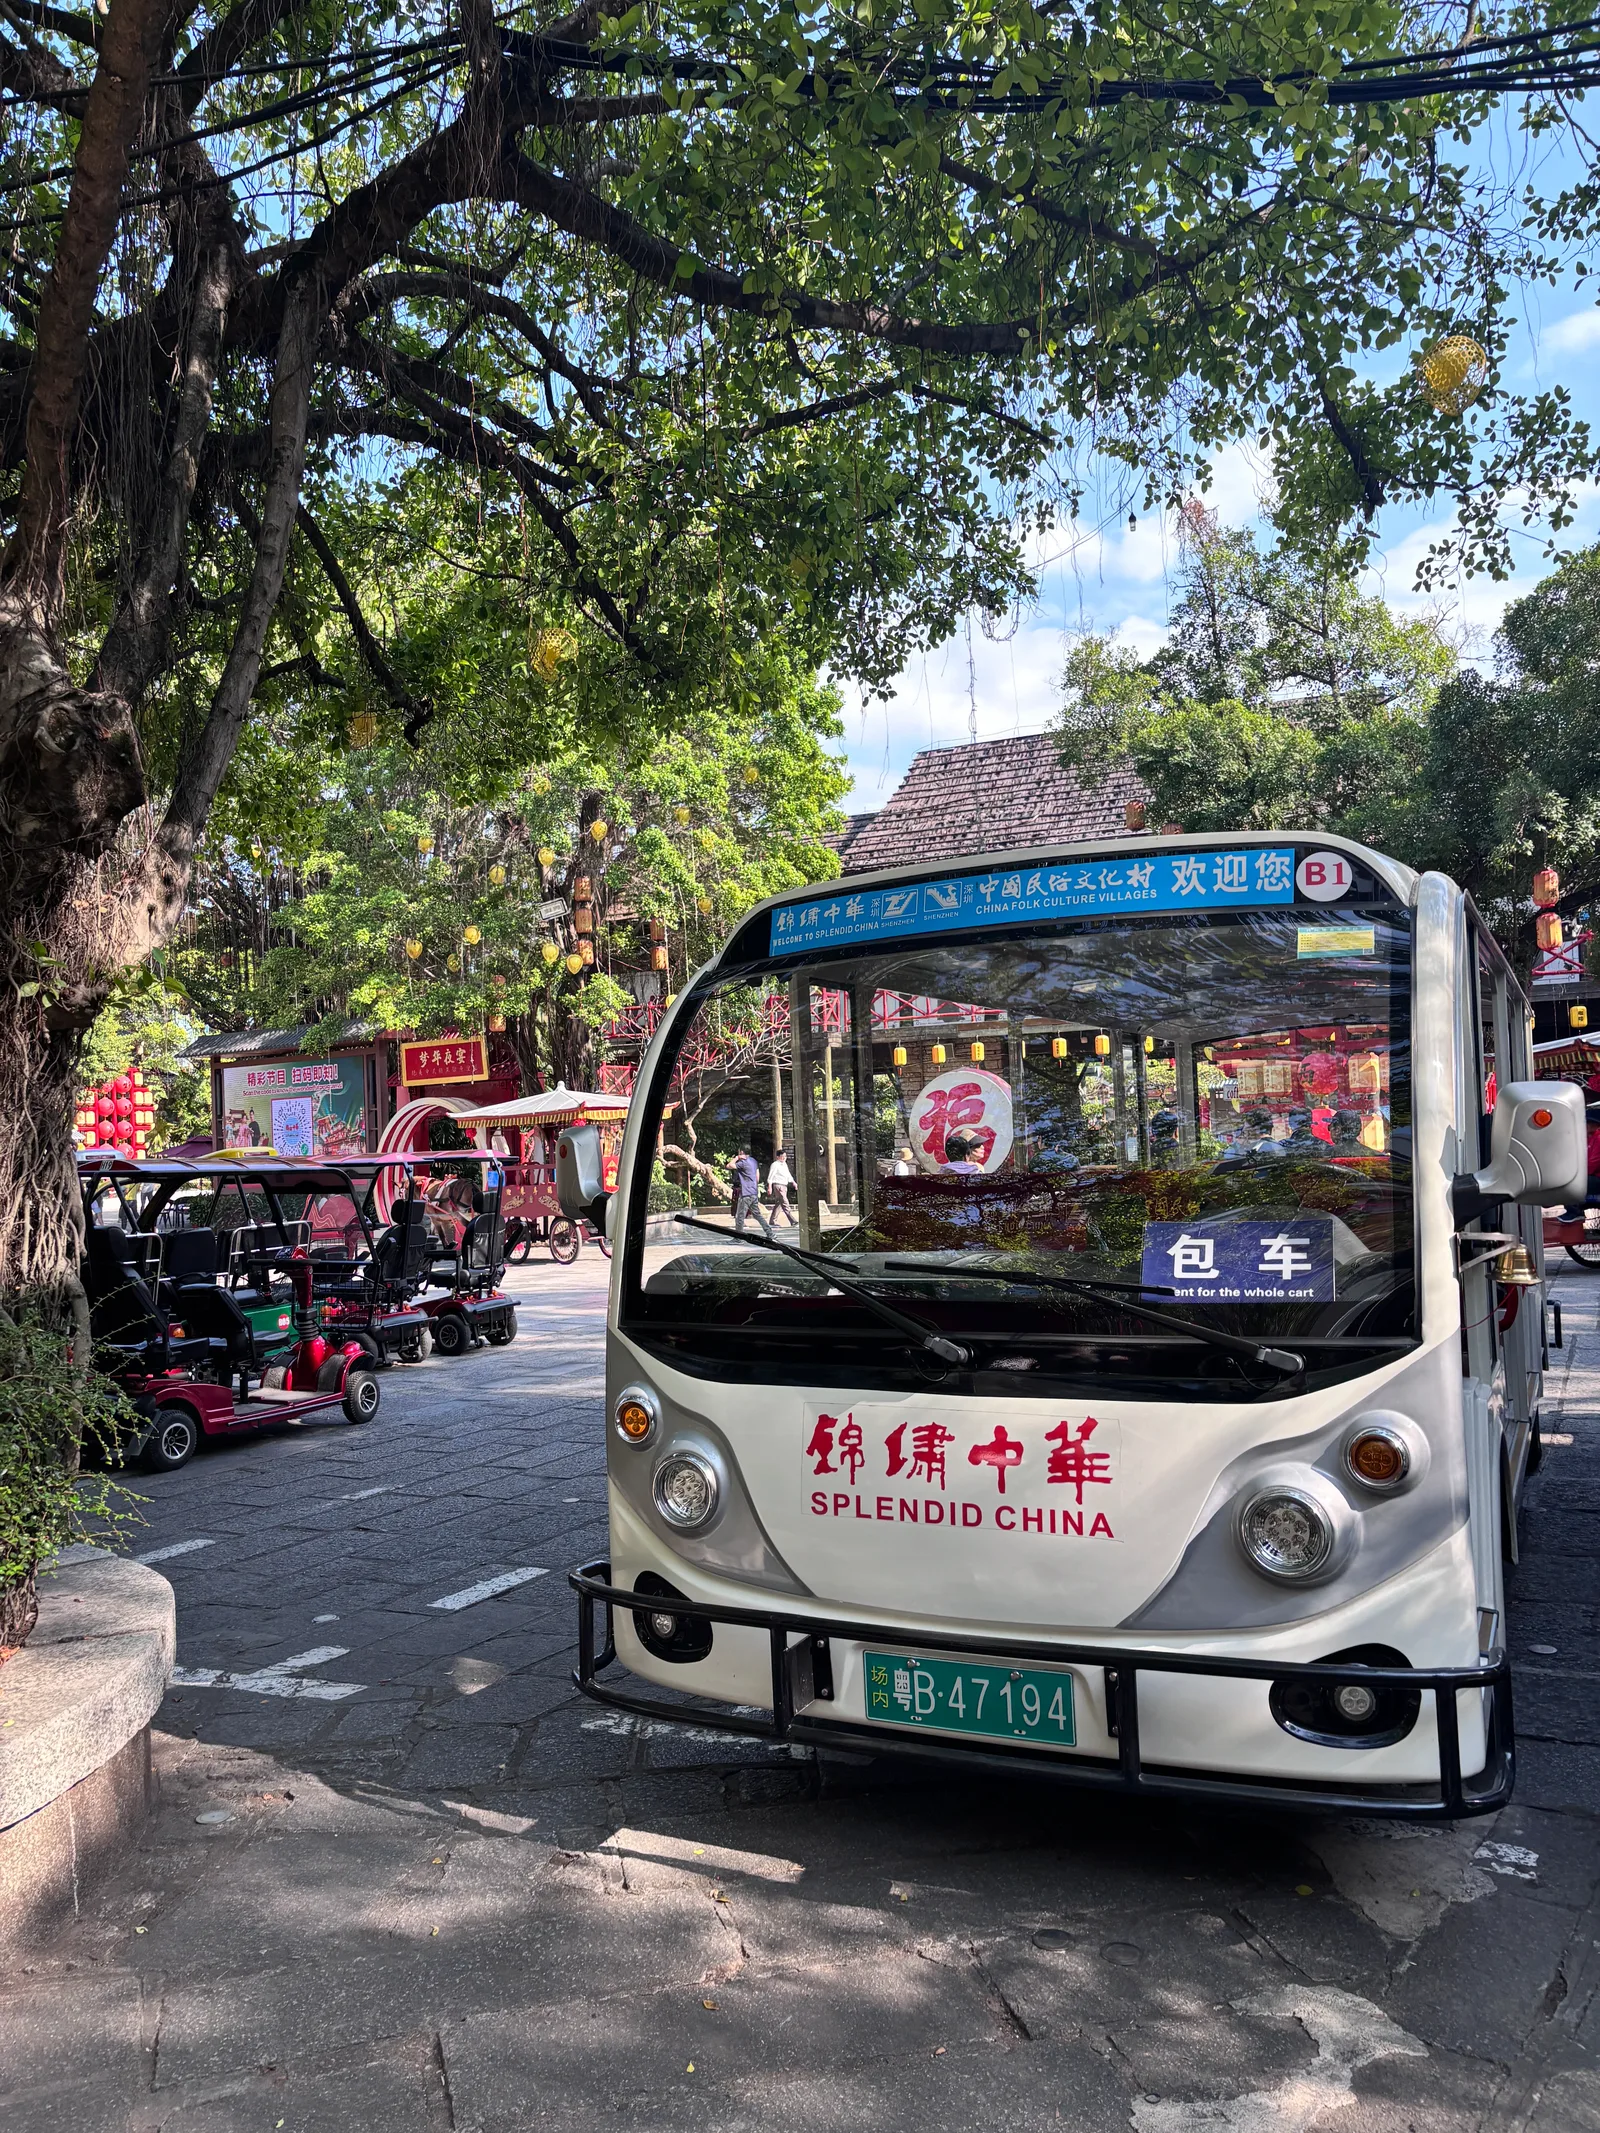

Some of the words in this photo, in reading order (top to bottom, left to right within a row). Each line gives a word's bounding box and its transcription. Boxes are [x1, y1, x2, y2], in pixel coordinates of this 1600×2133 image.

[1171, 852, 1292, 897] 欢迎您
[1305, 861, 1348, 886] B1
[963, 884, 974, 904] 深圳
[975, 903, 1009, 915] CHINA
[1011, 900, 1041, 911] FOLK
[1043, 894, 1096, 907] CULTURE
[1098, 889, 1157, 903] VILLAGES
[870, 898, 881, 918] 深圳
[923, 911, 959, 921] SHENZHEN
[772, 934, 803, 947] WELCOME
[805, 932, 814, 941] TO
[815, 924, 853, 939] SPLENDID
[854, 921, 879, 933] CHINA
[881, 918, 915, 928] SHENZHEN
[247, 1069, 287, 1087] 精彩节目
[919, 1082, 997, 1167] 福
[1166, 1233, 1312, 1280] 包车
[1174, 1287, 1194, 1297] ent
[1197, 1287, 1216, 1297] for
[1219, 1287, 1241, 1297] the
[1244, 1287, 1285, 1297] whole
[1288, 1287, 1314, 1298] cart
[810, 1491, 983, 1528] SPLENDID
[995, 1505, 1115, 1538] CHINA
[871, 1665, 889, 1709] 场内
